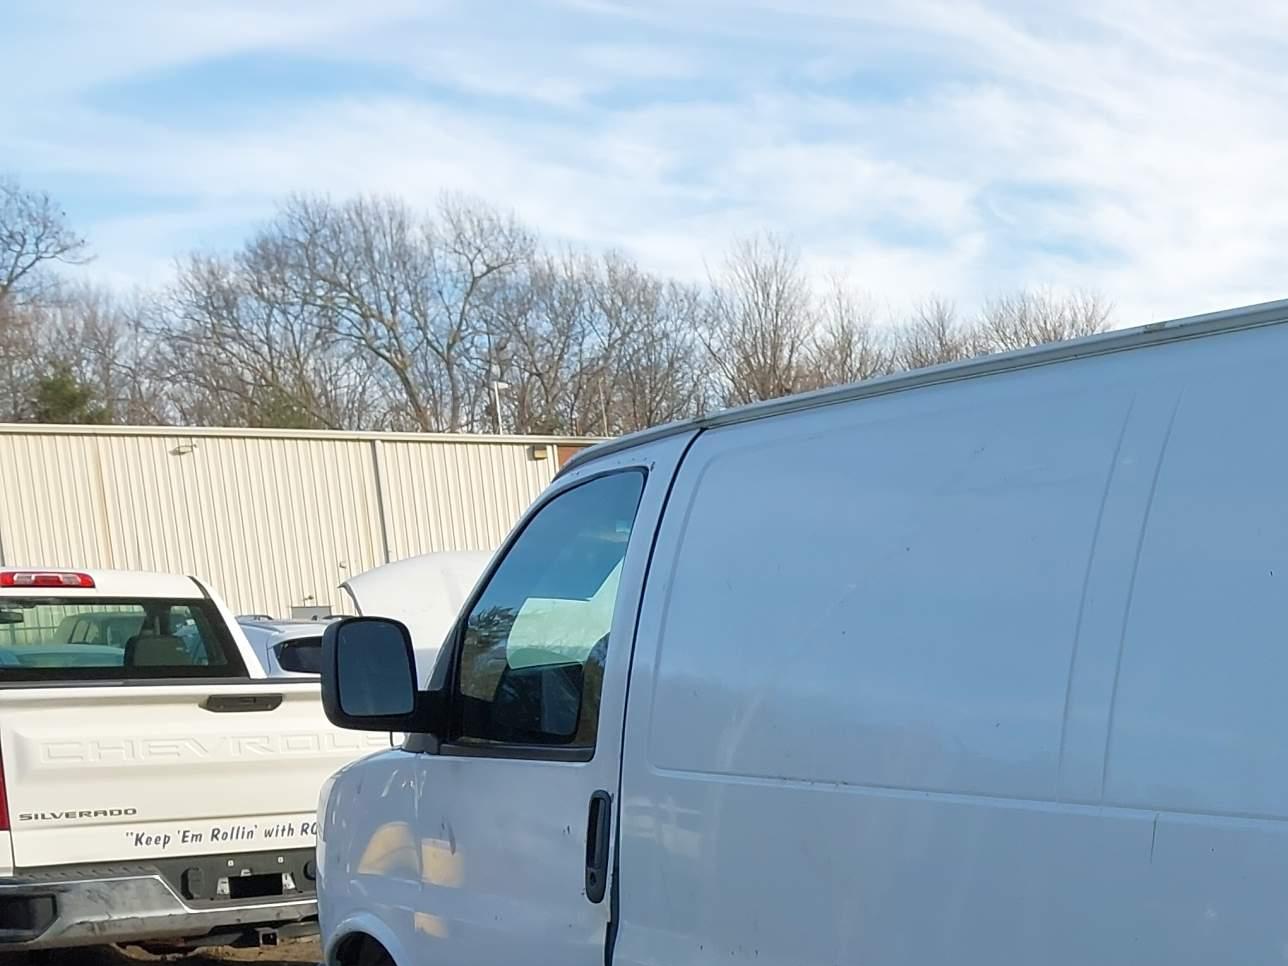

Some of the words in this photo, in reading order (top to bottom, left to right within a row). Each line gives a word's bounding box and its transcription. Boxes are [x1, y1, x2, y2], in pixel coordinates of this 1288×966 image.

[40, 732, 392, 763] CHEVROLE
[18, 807, 138, 821] SILVERADO
[125, 831, 171, 849] "Keep
[177, 829, 203, 844] 'Em
[210, 824, 258, 842] Rollin'
[264, 822, 295, 838] with
[300, 821, 318, 836] RO
